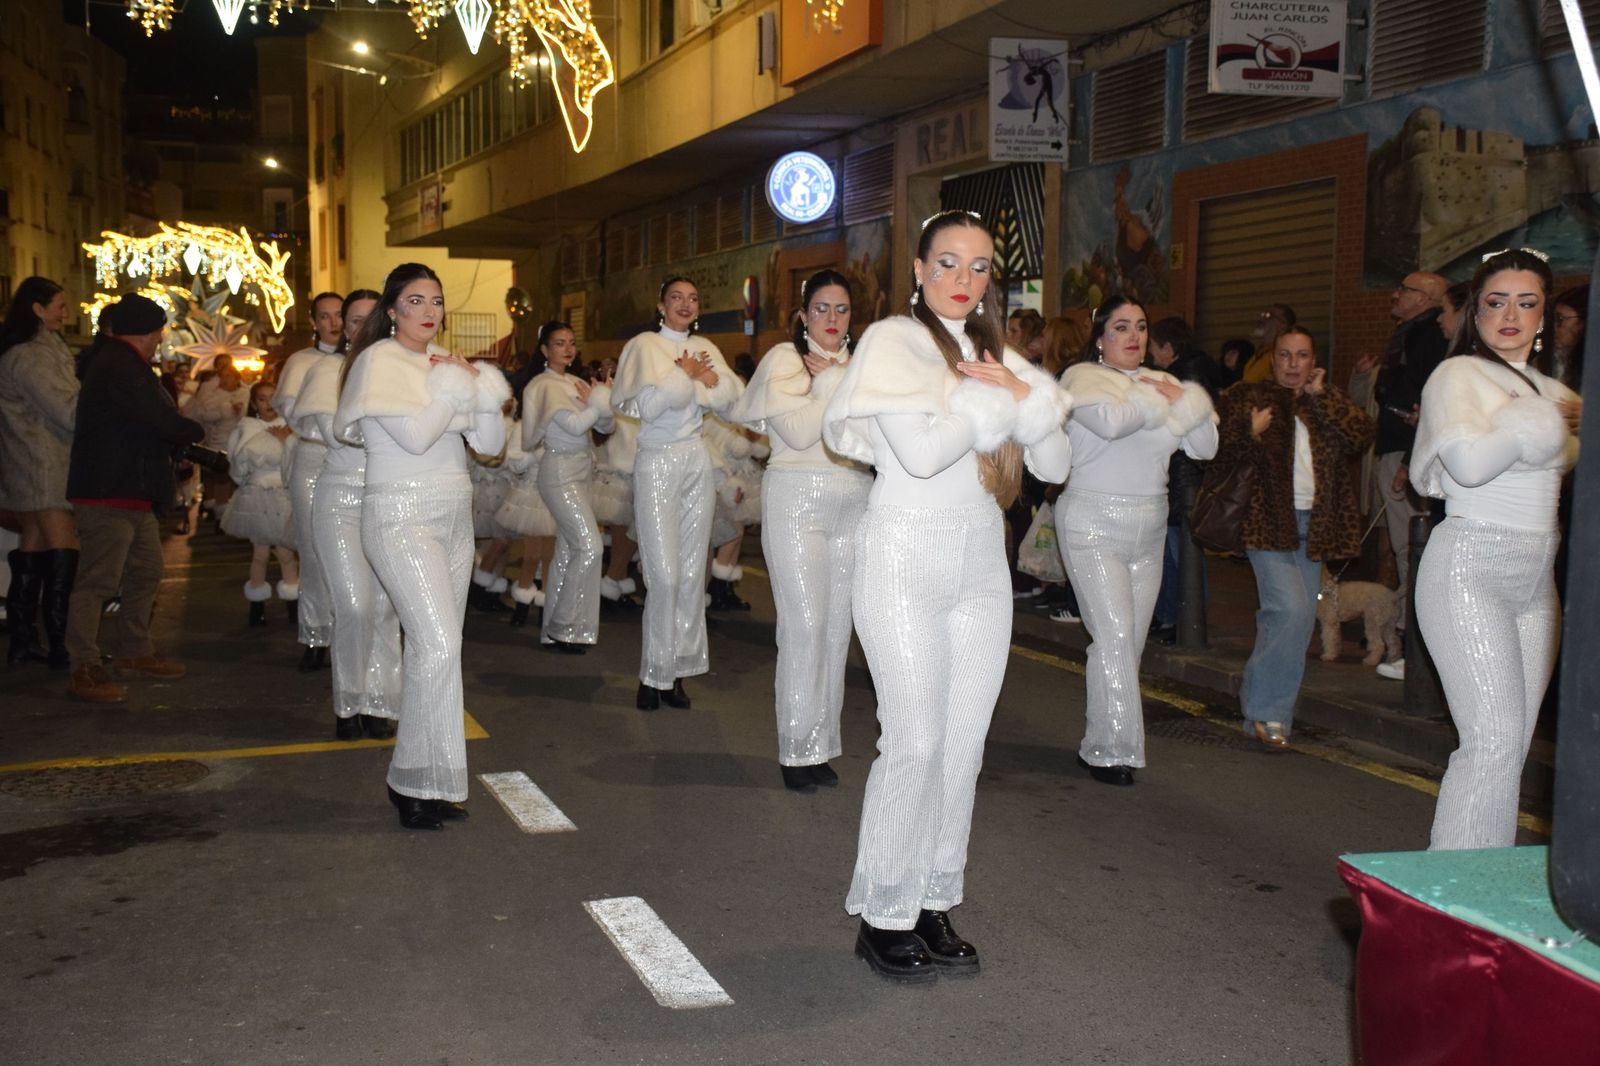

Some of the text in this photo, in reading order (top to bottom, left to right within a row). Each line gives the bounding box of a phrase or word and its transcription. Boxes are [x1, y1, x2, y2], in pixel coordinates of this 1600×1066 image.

[1230, 1, 1330, 13] CHARCUTERIA
[1230, 12, 1329, 24] JUAN CARLOS
[916, 109, 983, 167] REAL
